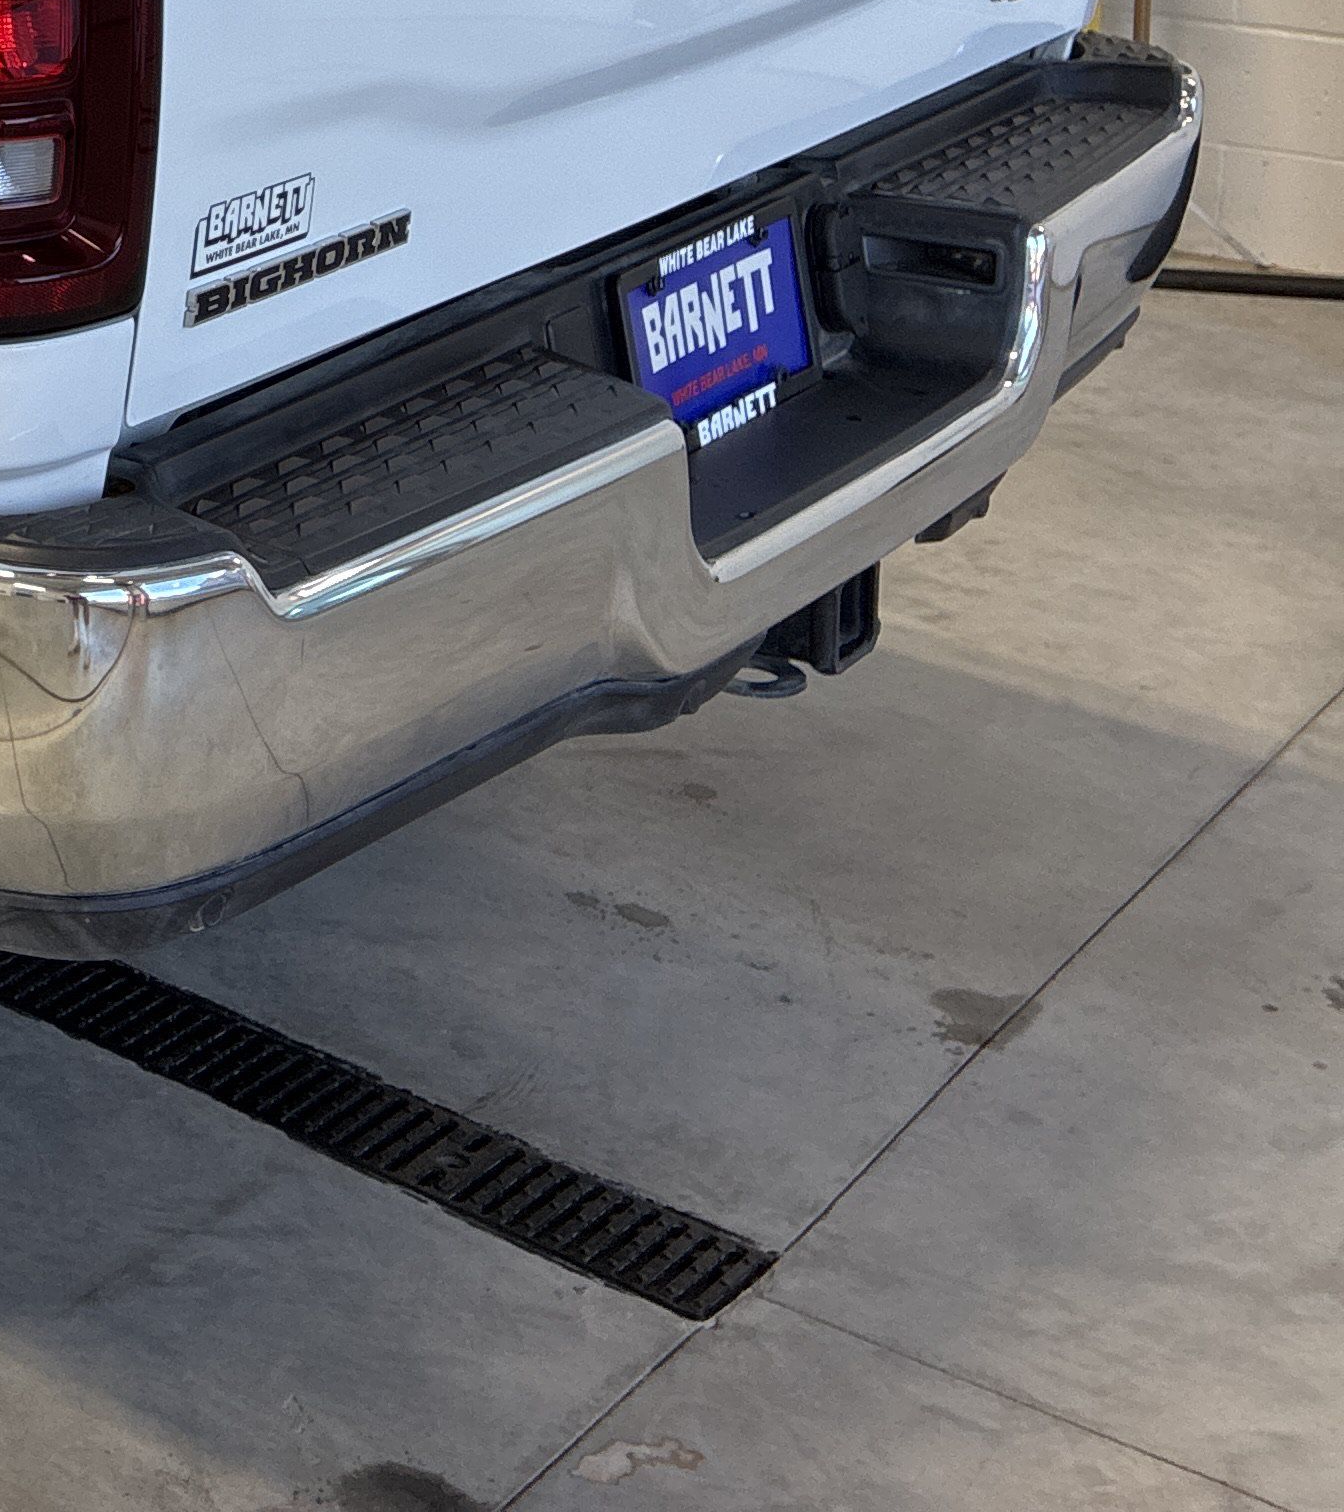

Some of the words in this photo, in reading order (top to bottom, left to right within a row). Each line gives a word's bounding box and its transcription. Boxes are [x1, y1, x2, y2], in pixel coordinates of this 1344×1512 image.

[203, 172, 312, 247] BARNETT
[205, 245, 234, 264] WHITE
[235, 237, 258, 255] BEAR
[259, 228, 284, 246] LAKE,
[285, 220, 301, 236] MN
[183, 207, 412, 328] BIGHORN
[658, 243, 695, 278] WHITE
[695, 229, 725, 262] BEAR
[726, 214, 755, 247] LAKE
[641, 247, 774, 375] BARNETT
[697, 381, 777, 448] BARNETT
